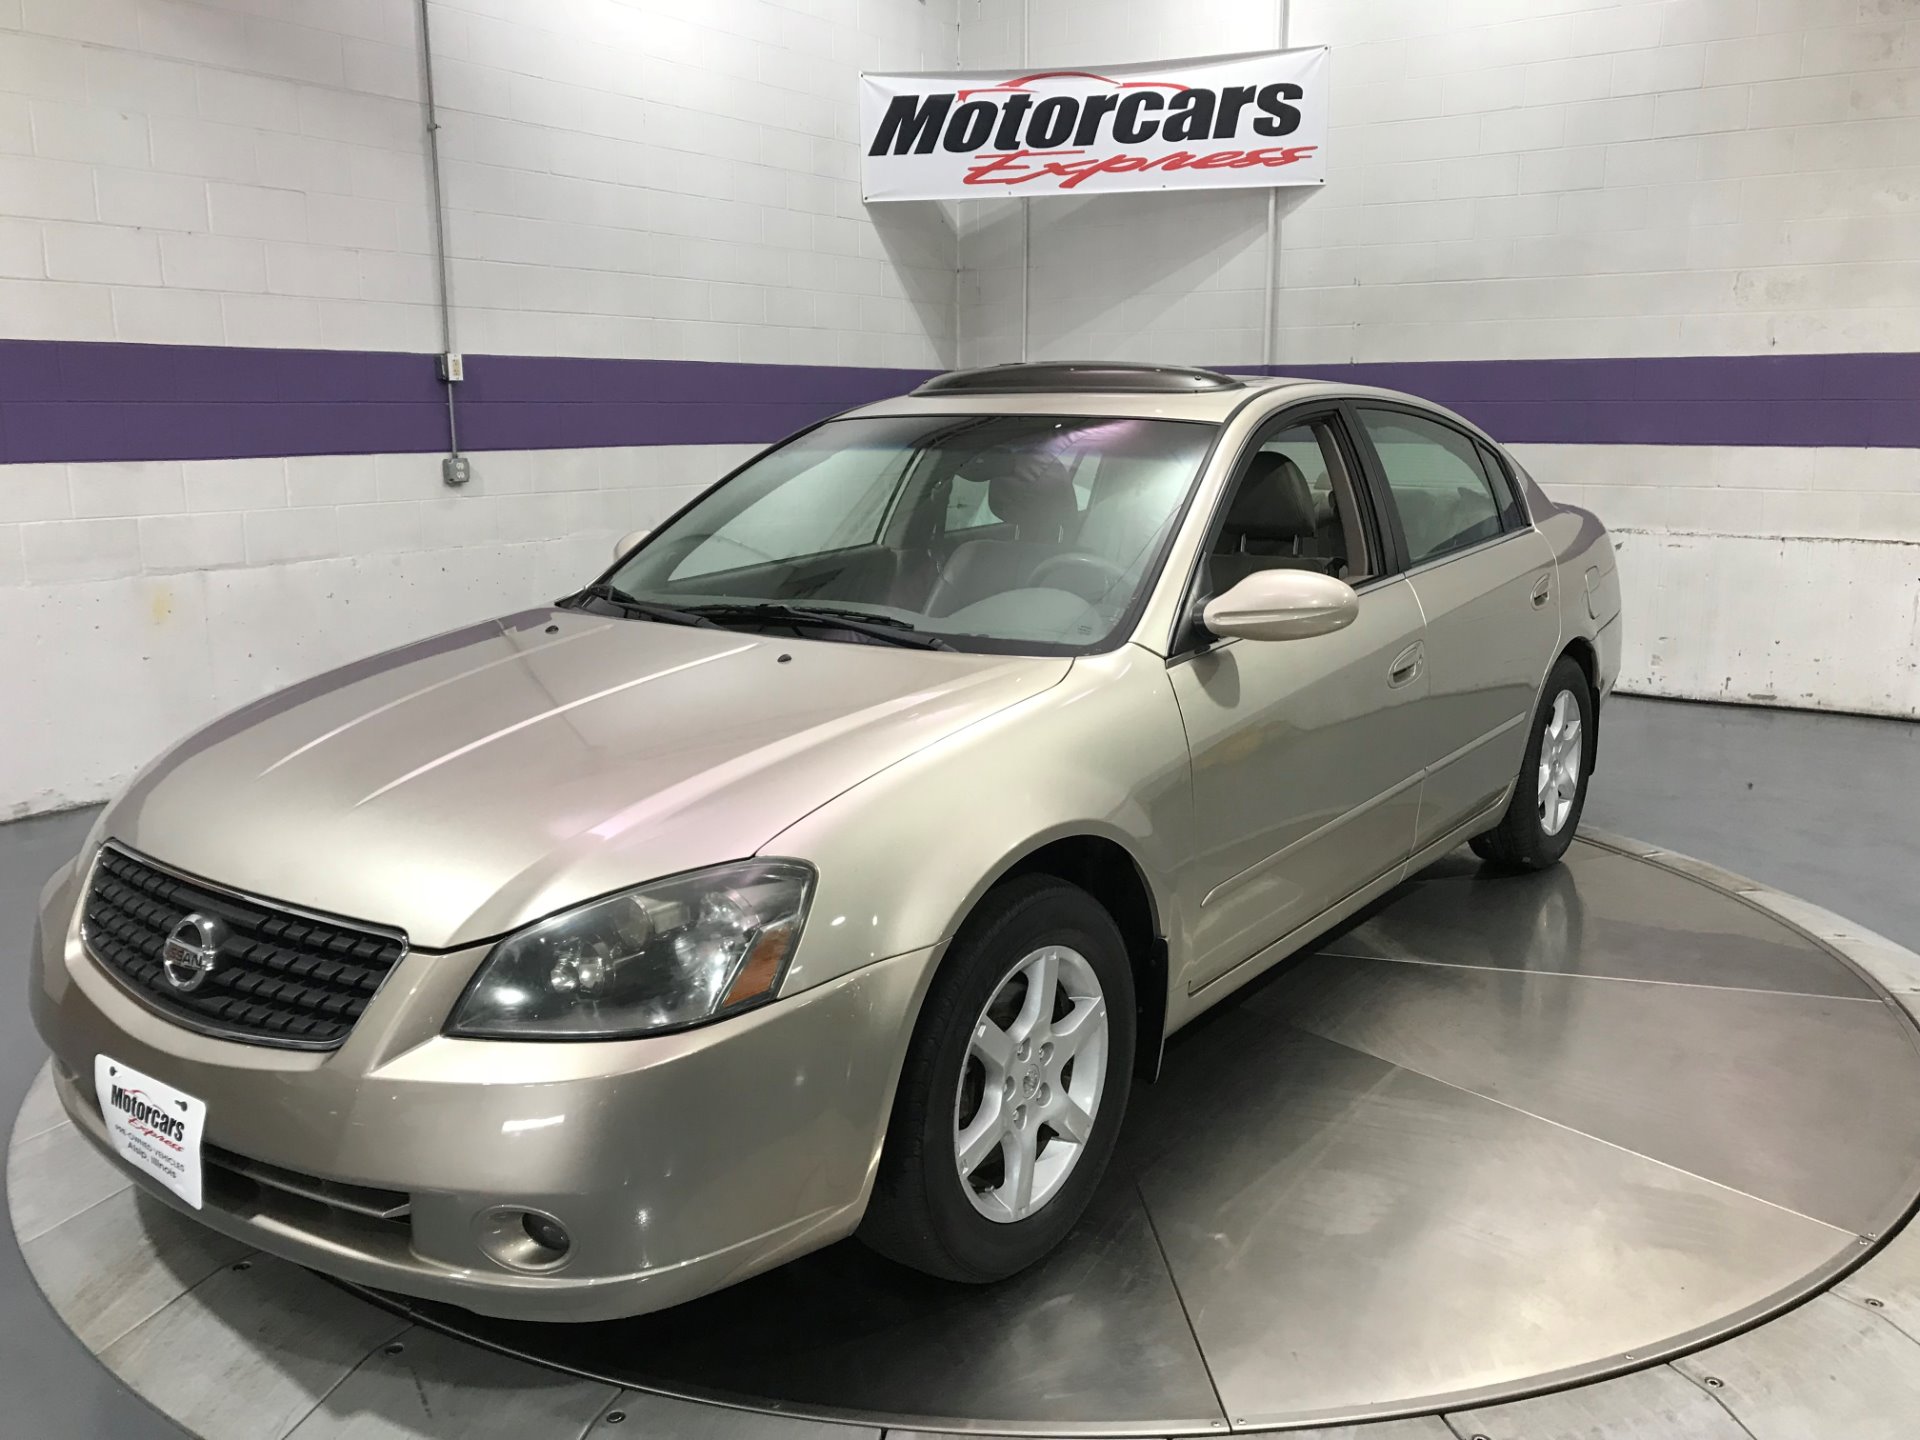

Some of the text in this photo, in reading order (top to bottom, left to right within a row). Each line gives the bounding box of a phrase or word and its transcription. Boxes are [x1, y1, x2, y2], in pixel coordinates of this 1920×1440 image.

[868, 81, 1304, 157] Motorcars
[962, 145, 1319, 189] Express
[111, 1084, 185, 1142] Motorcars
[127, 1116, 185, 1152] Express
[151, 1157, 177, 1179] Illinois
